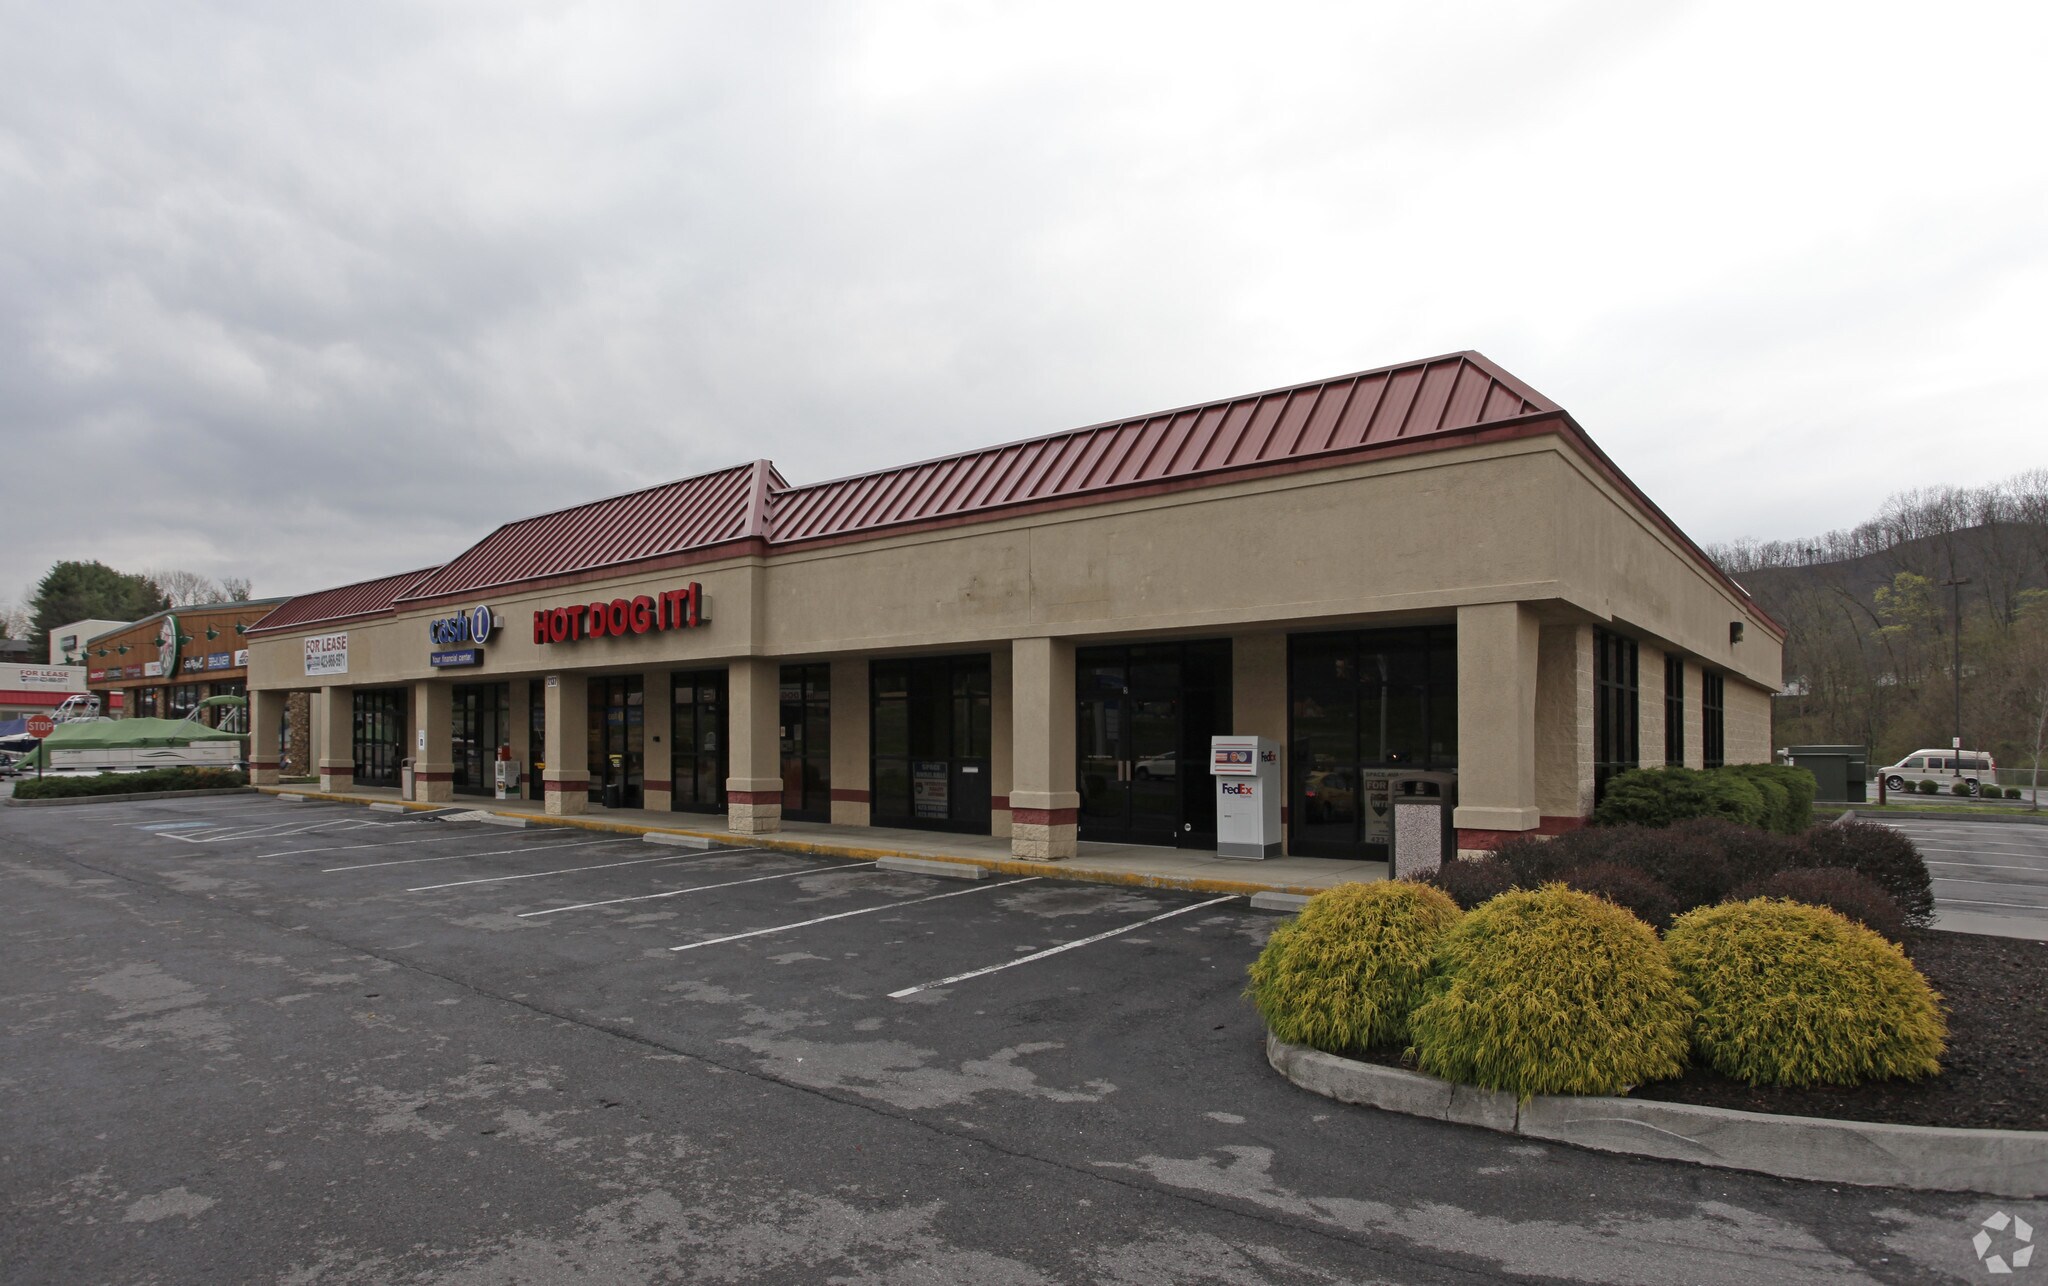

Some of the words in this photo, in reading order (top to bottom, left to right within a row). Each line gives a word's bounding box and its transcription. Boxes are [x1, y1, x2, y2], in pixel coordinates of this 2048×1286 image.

[534, 605, 587, 645] HOT
[589, 595, 654, 639] DOG
[659, 582, 700, 631] IT!
[430, 610, 469, 645] cash
[306, 640, 320, 653] FOR
[322, 636, 346, 652] LEASE
[442, 654, 457, 663] financial
[28, 722, 53, 731] STOP
[1261, 751, 1276, 763] FedEx
[1222, 783, 1253, 795] FedEx
[1367, 780, 1386, 789] FOR
